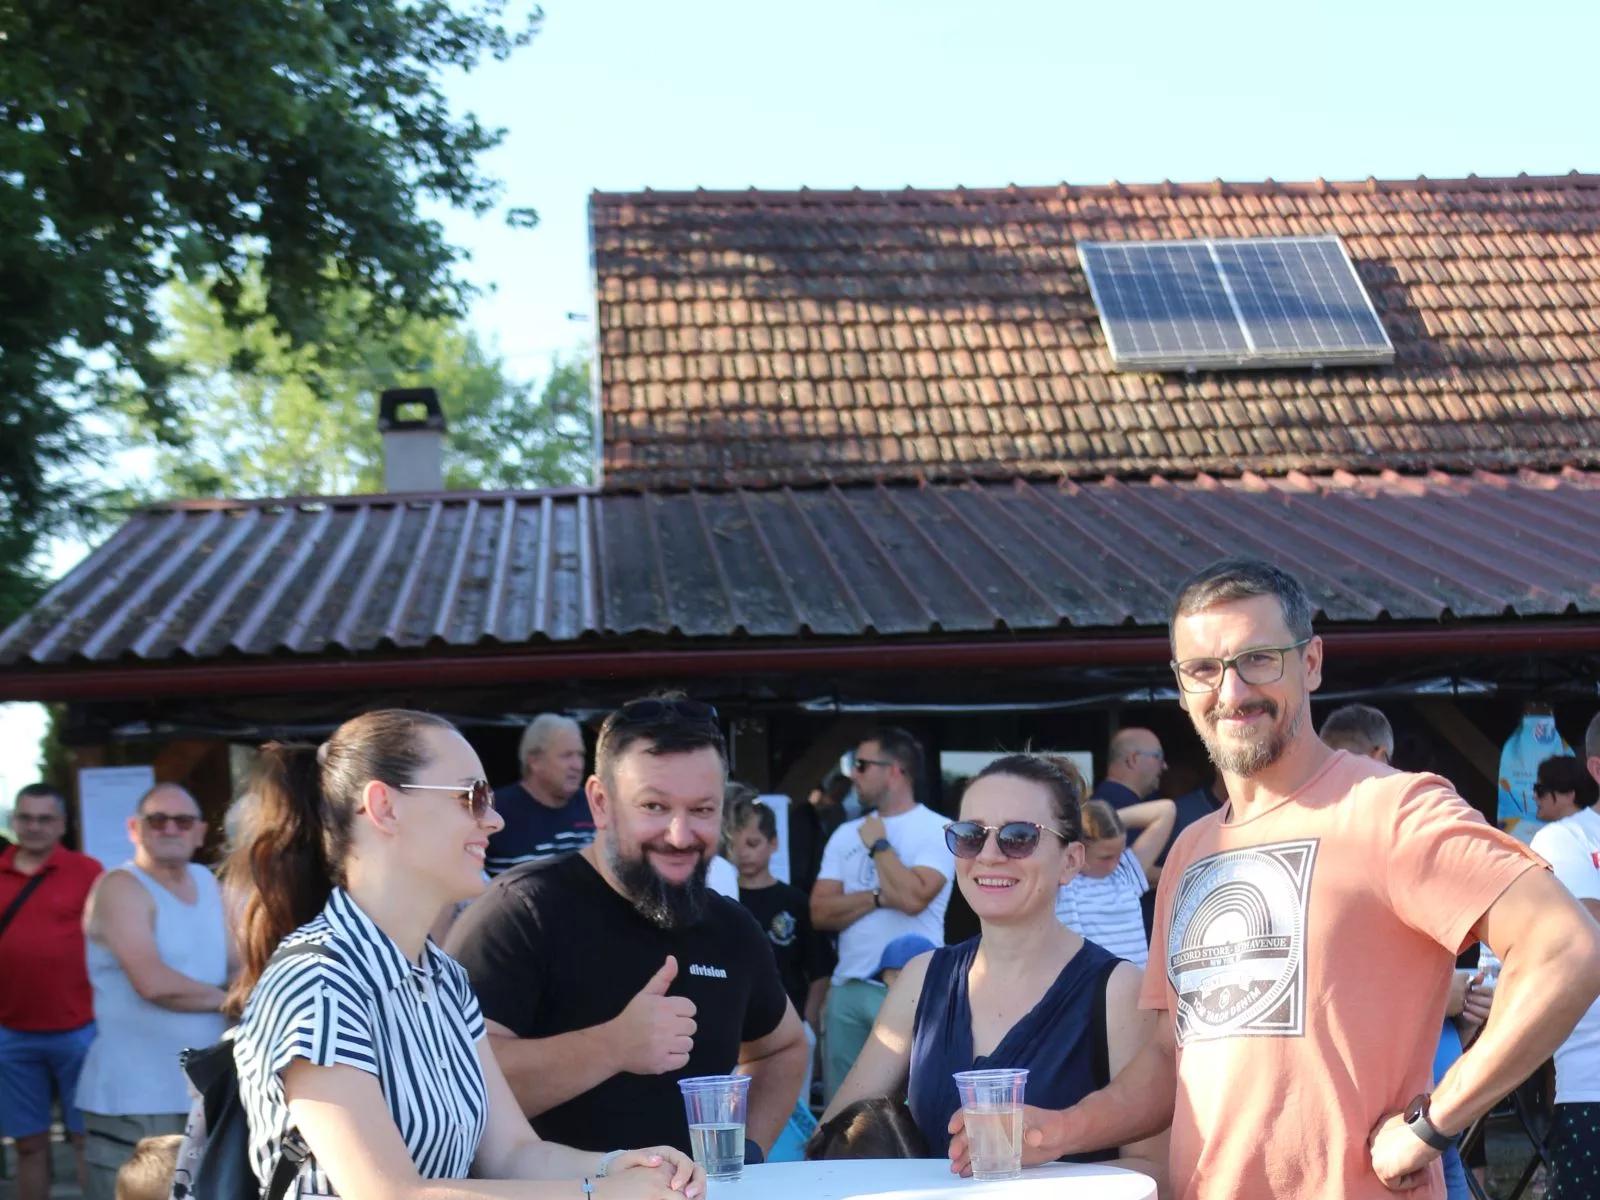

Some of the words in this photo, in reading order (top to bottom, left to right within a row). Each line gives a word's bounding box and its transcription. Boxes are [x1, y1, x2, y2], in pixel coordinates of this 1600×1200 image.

[1172, 950, 1201, 966] RECORD
[1202, 945, 1230, 958] STORE
[1249, 937, 1287, 950] AVENUE
[689, 963, 728, 979] division
[1230, 986, 1262, 1016] DENIM
